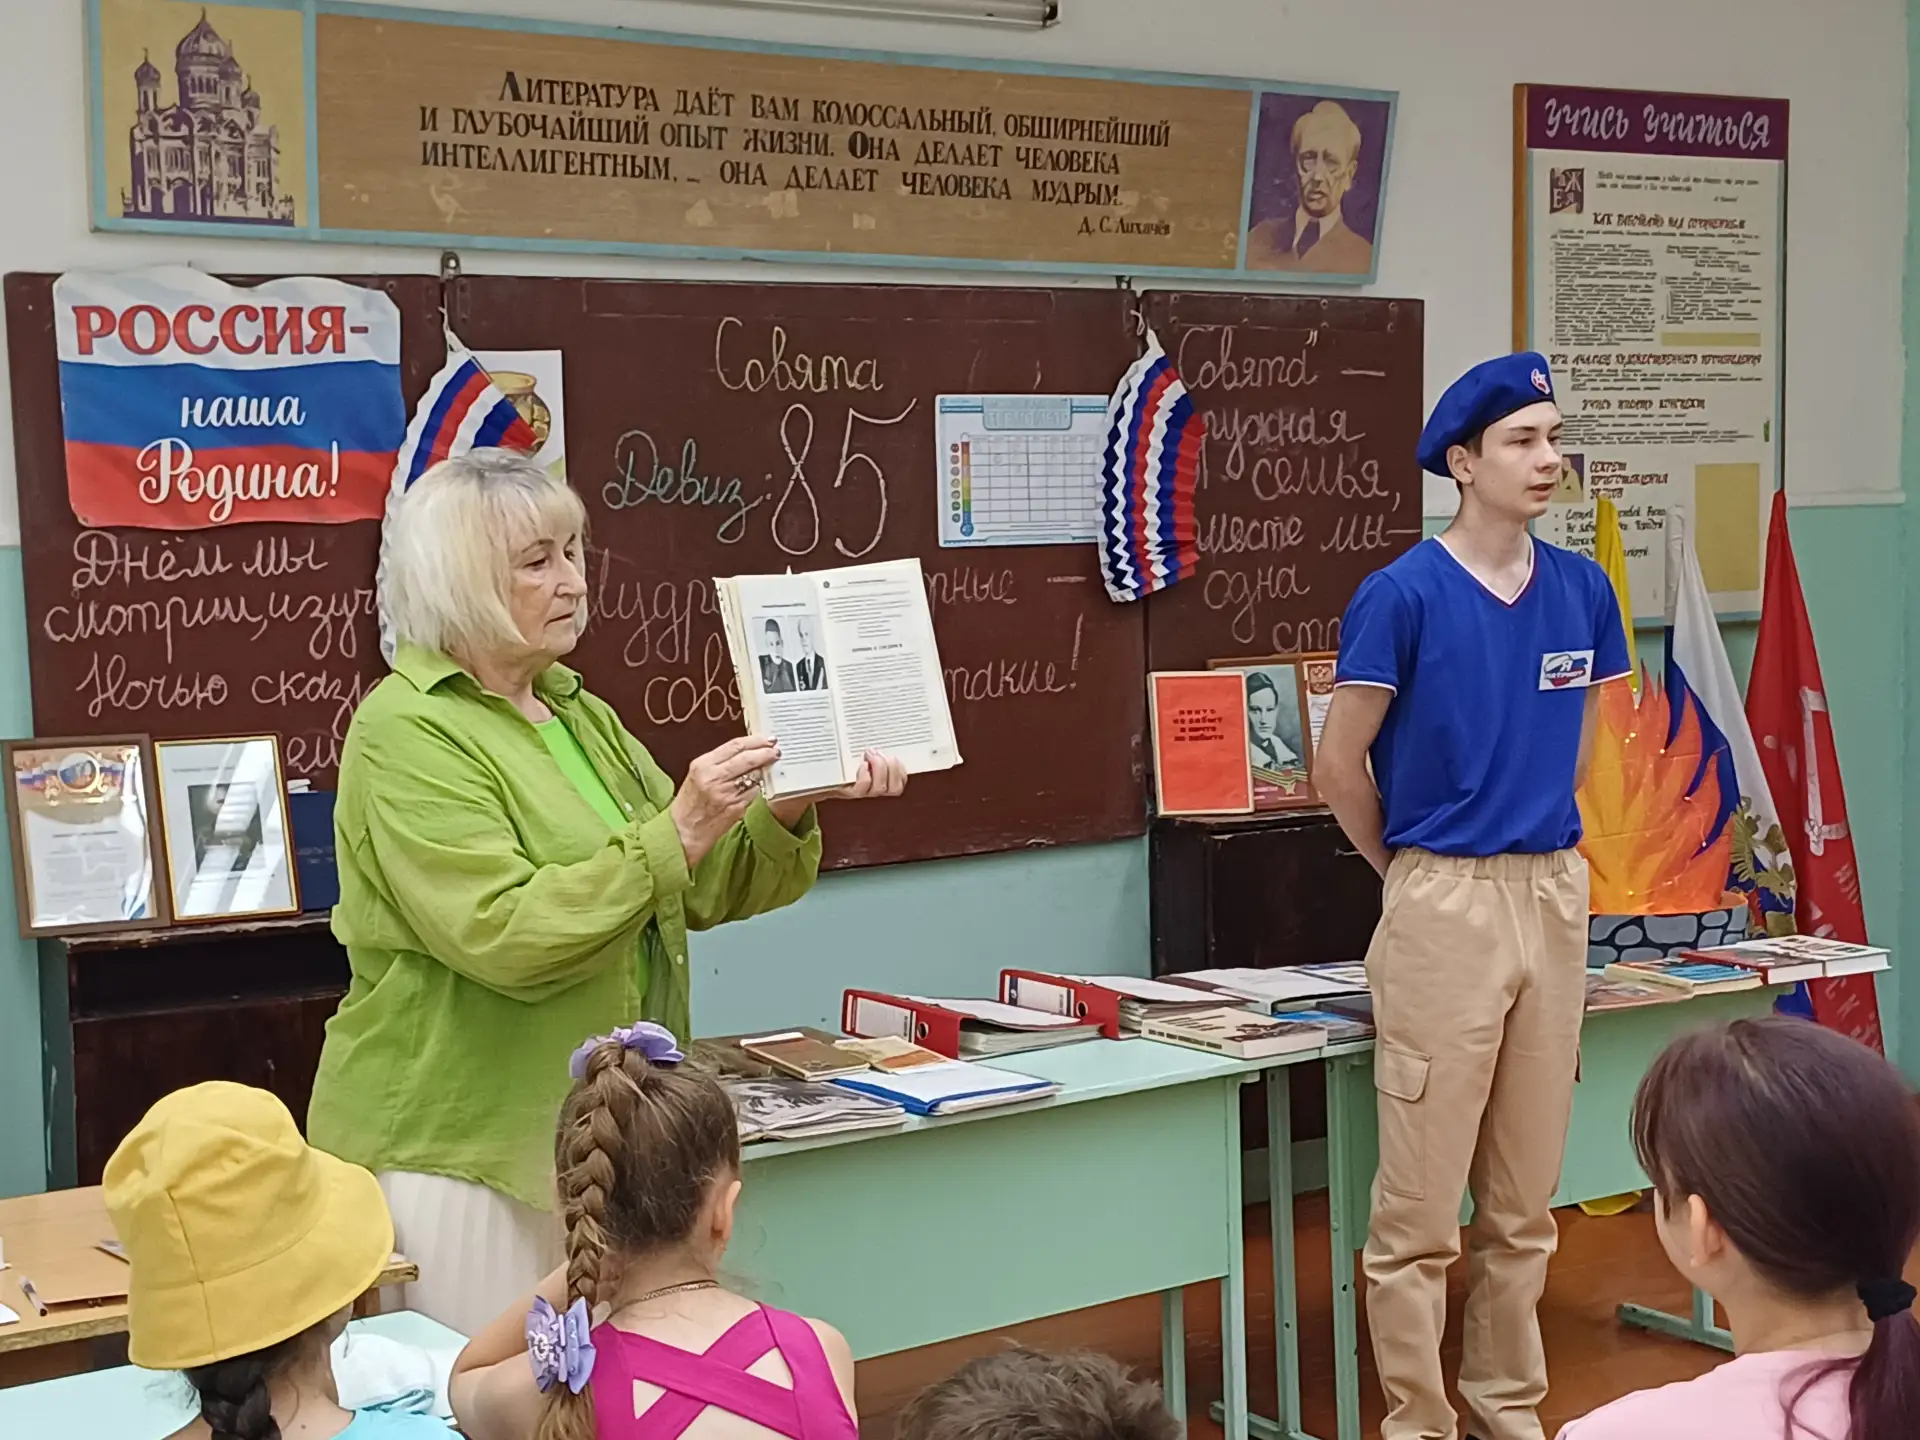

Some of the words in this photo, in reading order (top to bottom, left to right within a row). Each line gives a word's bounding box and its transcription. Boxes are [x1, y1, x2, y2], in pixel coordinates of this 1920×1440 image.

[419, 105, 438, 132] И
[452, 106, 650, 146] ГЛУБОЧАЙШИЙ
[660, 122, 728, 151] ОПЫТ
[743, 128, 834, 157] ЖИЗНИ.
[848, 131, 900, 161] ОНА
[914, 140, 1003, 168] ДЕЛАЕТ
[1015, 146, 1120, 176] ЧЕЛОВЕКА
[499, 71, 660, 112] ЛИТЕРАТУРА
[673, 86, 735, 118] ДАЁТ
[750, 93, 800, 122] ВАМ
[1004, 113, 1171, 147] ОБШИРНЕЙШИЙ
[719, 160, 768, 187] ОНА
[784, 165, 878, 192] ДЕЛАЕТ
[902, 171, 1012, 201] ЧЕЛОВЕКА
[1078, 216, 1095, 236] Д.
[1099, 216, 1112, 235] С.
[71, 304, 369, 355] РОССИЯ-
[716, 316, 884, 392] Совята
[181, 394, 306, 428] наша
[137, 437, 340, 522] Родина!
[772, 398, 916, 558] 85
[1197, 408, 1366, 490] ружная
[242, 536, 328, 577] мы
[1195, 512, 1305, 554] месте
[1204, 564, 1311, 644] одна
[76, 651, 228, 718] Ночью
